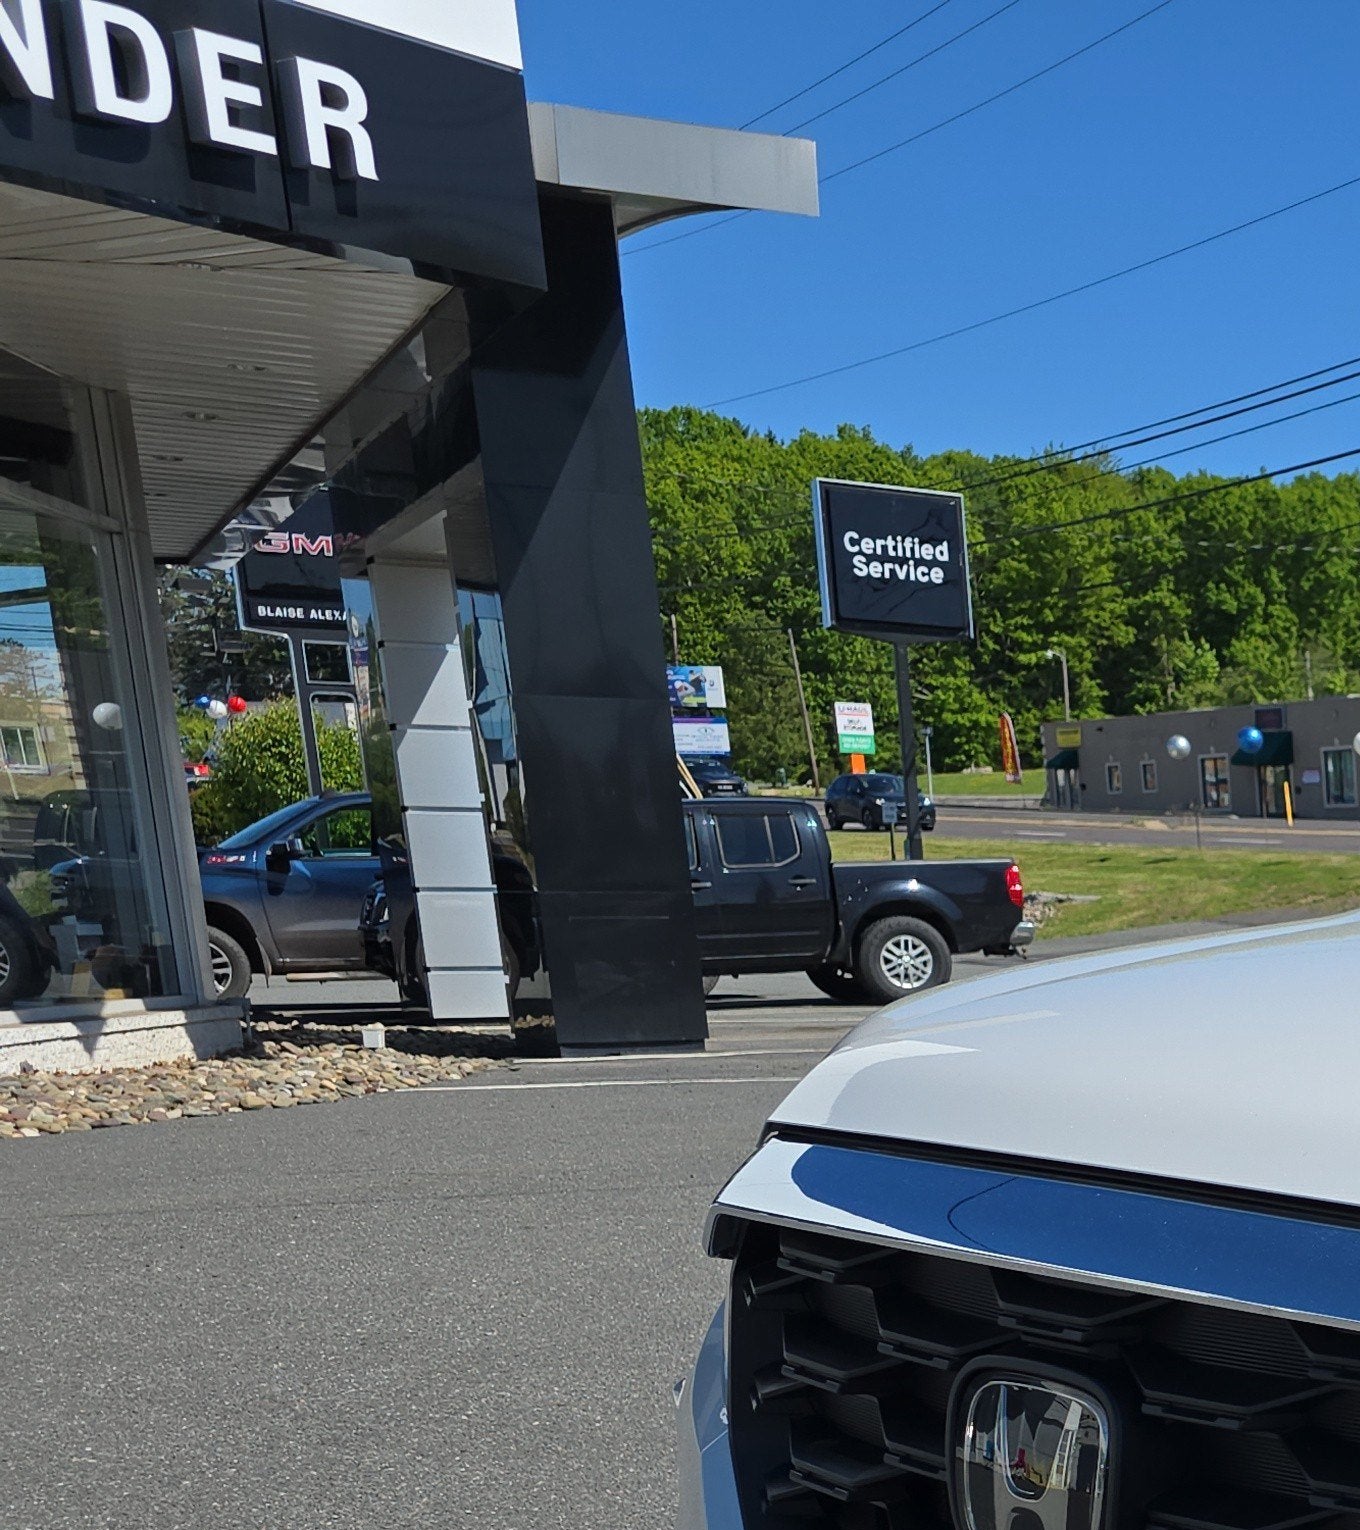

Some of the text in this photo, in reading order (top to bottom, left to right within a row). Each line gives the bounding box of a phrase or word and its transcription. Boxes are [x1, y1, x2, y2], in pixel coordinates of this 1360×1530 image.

[843, 530, 950, 562] Certified
[852, 554, 945, 584] Service
[257, 605, 305, 619] BLAISE
